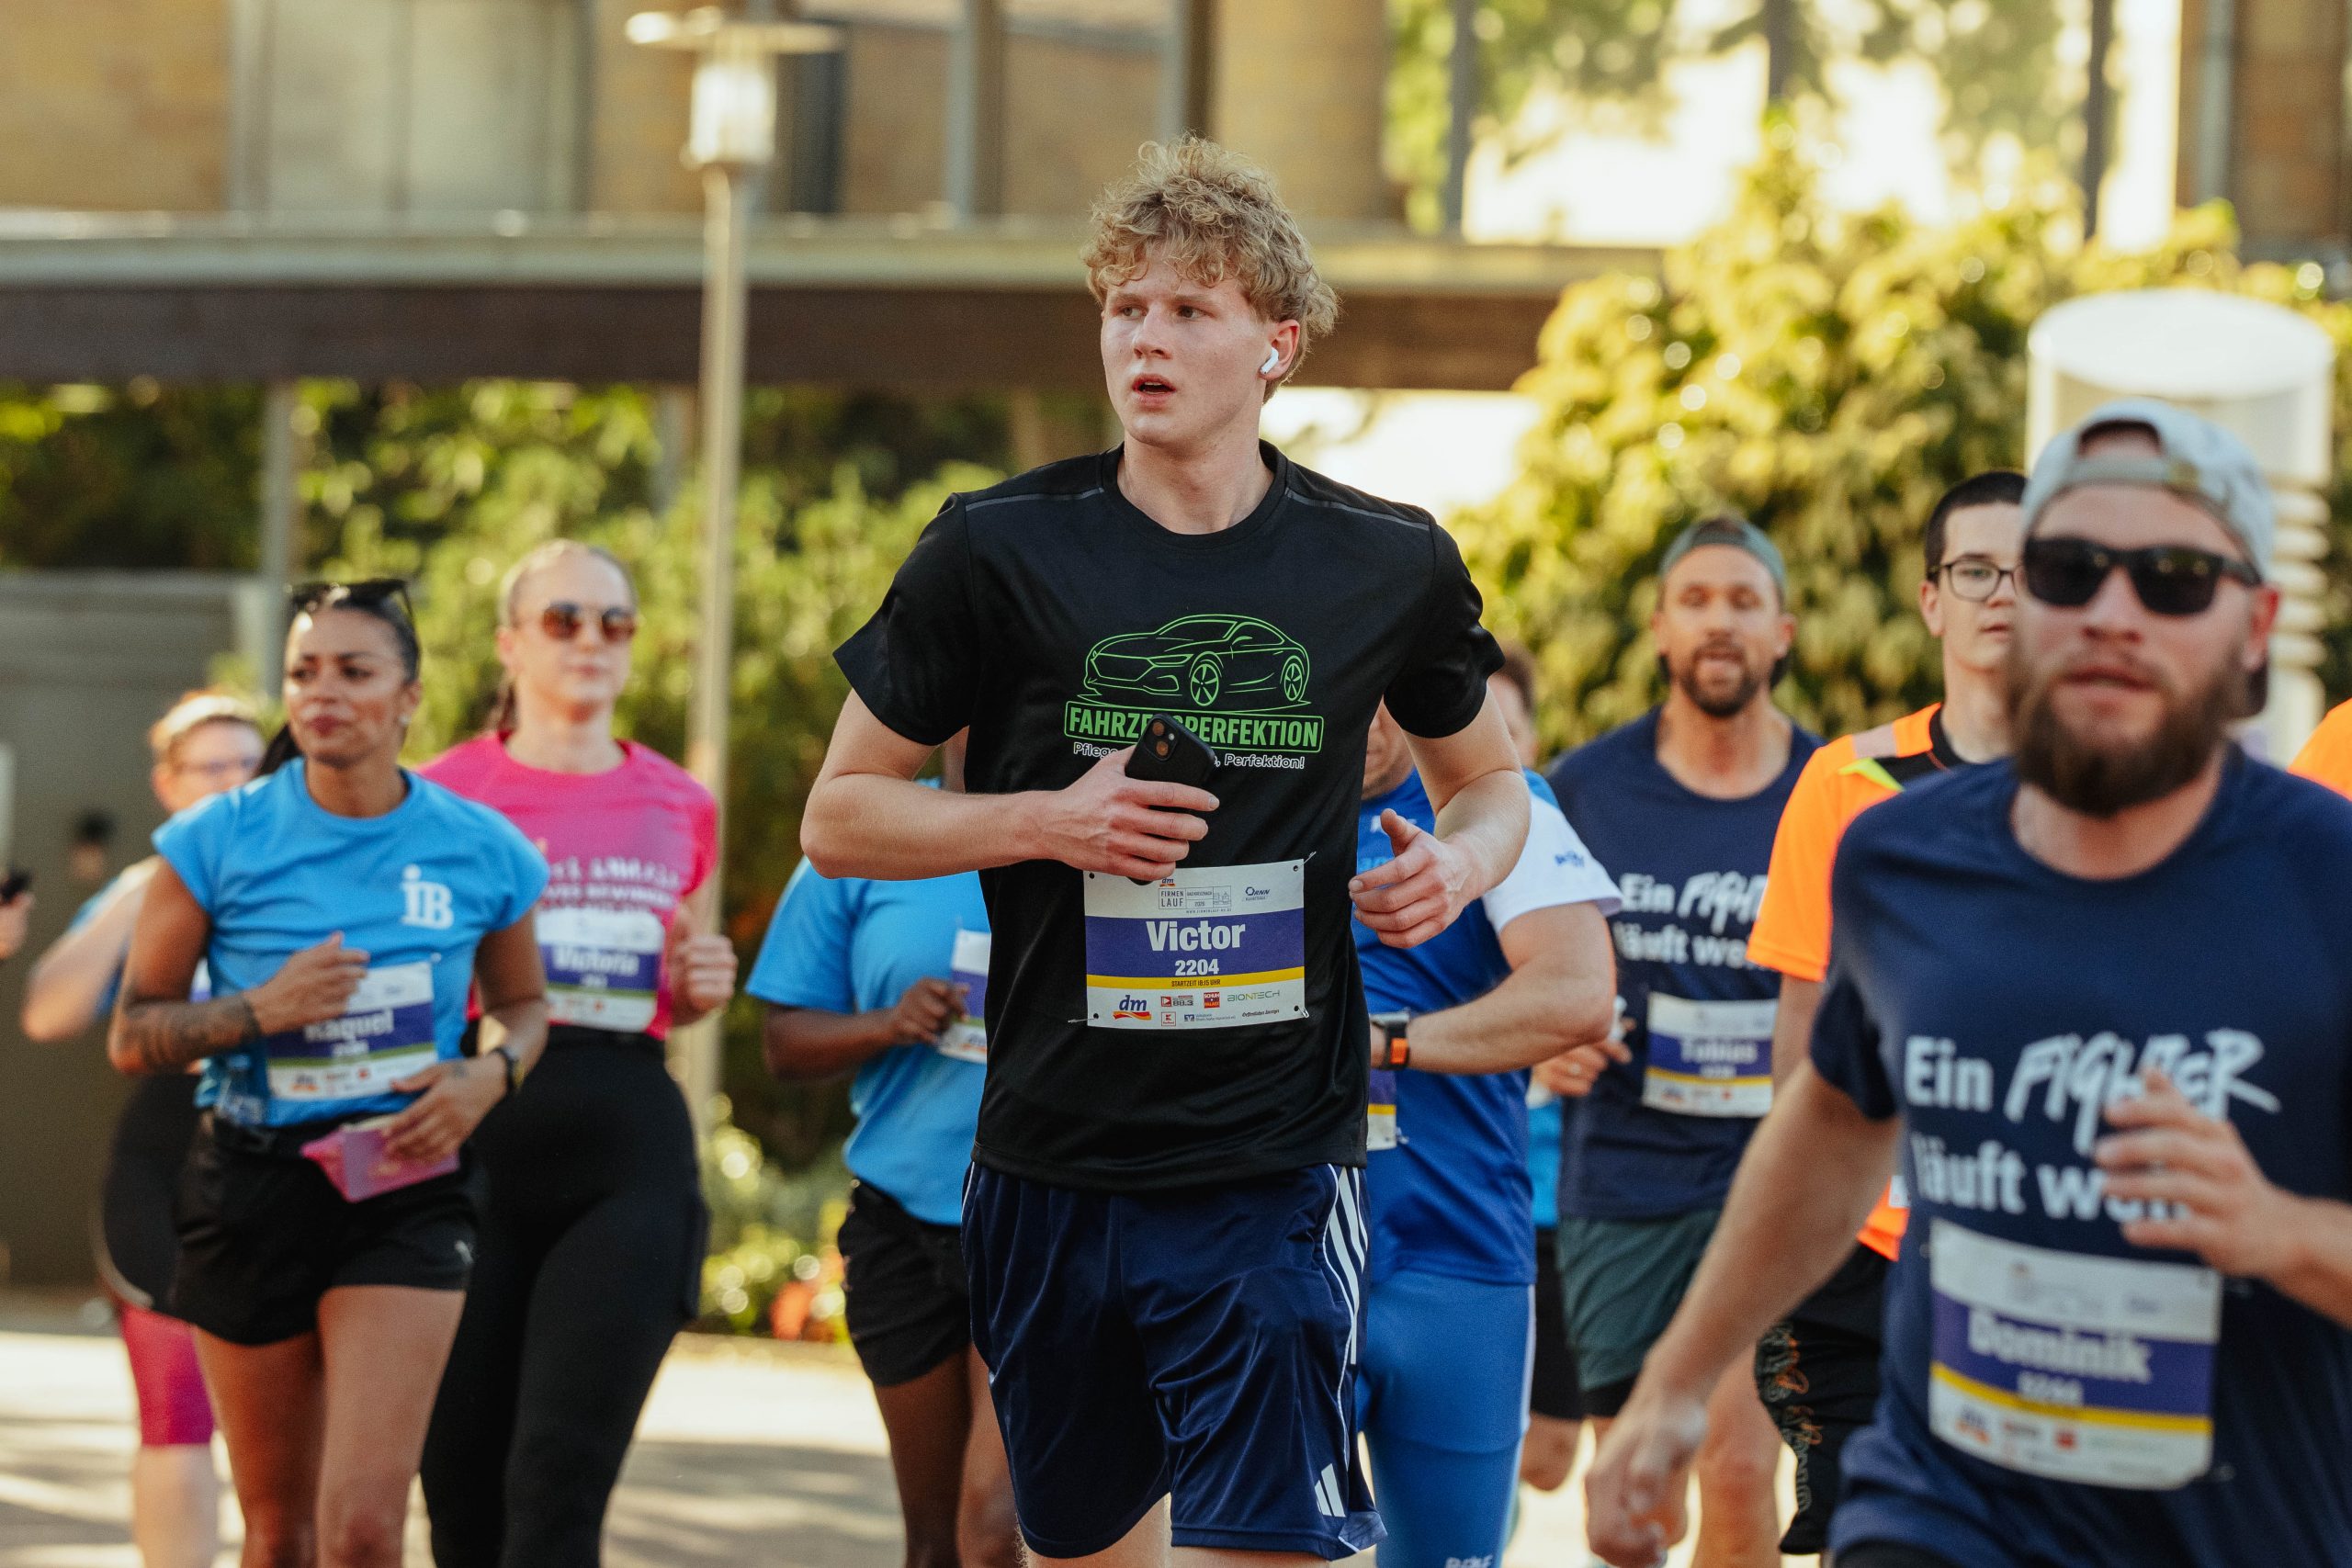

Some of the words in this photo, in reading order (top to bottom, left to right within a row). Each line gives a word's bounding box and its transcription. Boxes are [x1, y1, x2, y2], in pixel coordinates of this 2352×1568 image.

[1069, 707, 1319, 747] FAHRZPERFEKTION
[1224, 753, 1305, 769] Perfektion!
[1160, 898, 1183, 908] LAUF
[1146, 920, 1246, 952] Victor
[1174, 958, 1219, 976] 2204
[1118, 995, 1148, 1012] dm
[1227, 990, 1281, 1002] BIONTECH
[1905, 1035, 1995, 1112] Ein
[1909, 1130, 2026, 1215] läuft
[1968, 1306, 2152, 1384] Dominik
